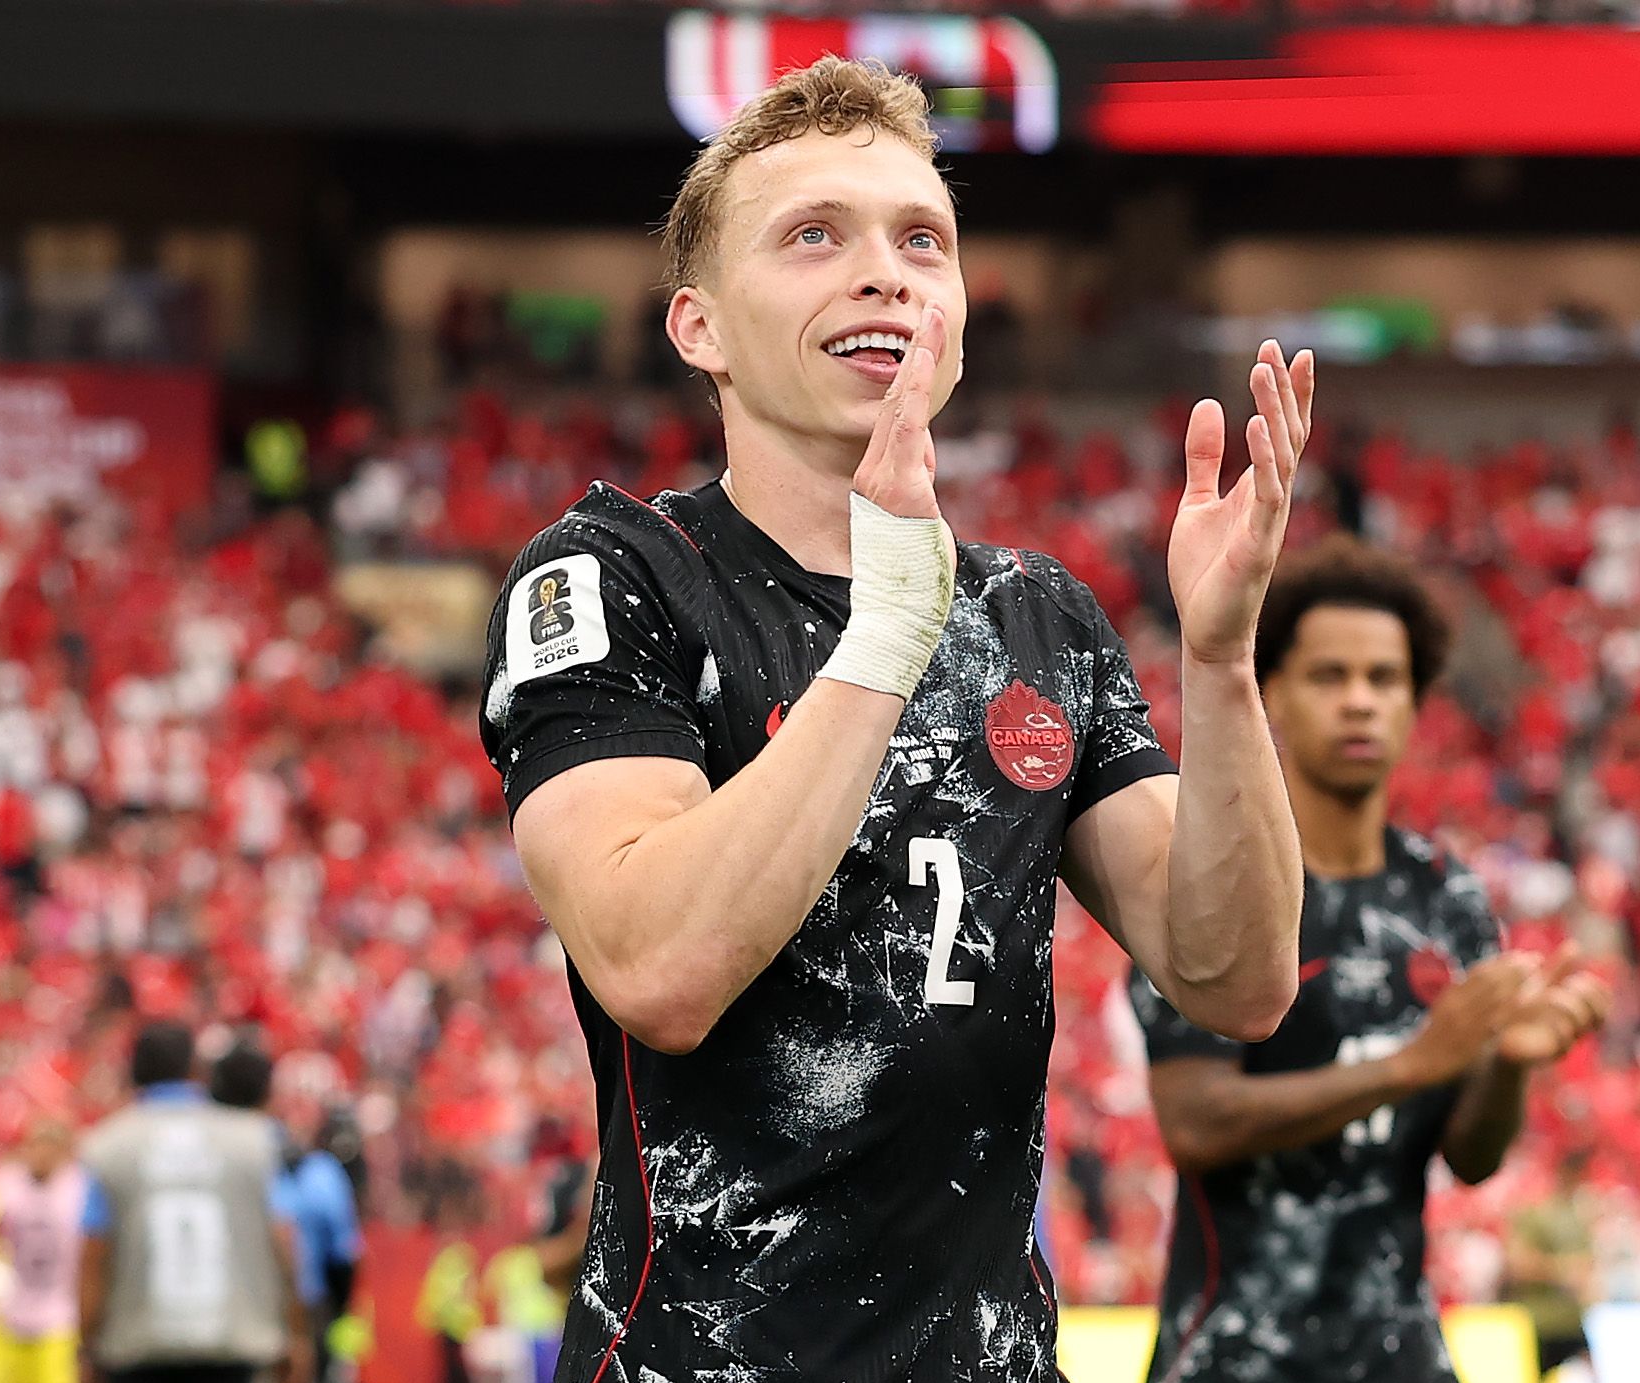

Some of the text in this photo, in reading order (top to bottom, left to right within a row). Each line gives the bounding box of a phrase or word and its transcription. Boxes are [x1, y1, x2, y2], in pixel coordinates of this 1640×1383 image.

[541, 622, 563, 638] FIFA
[534, 636, 578, 657] WORLD CUP
[534, 644, 580, 669] 2026
[991, 730, 1070, 746] CANADA
[908, 837, 975, 1006] 2
